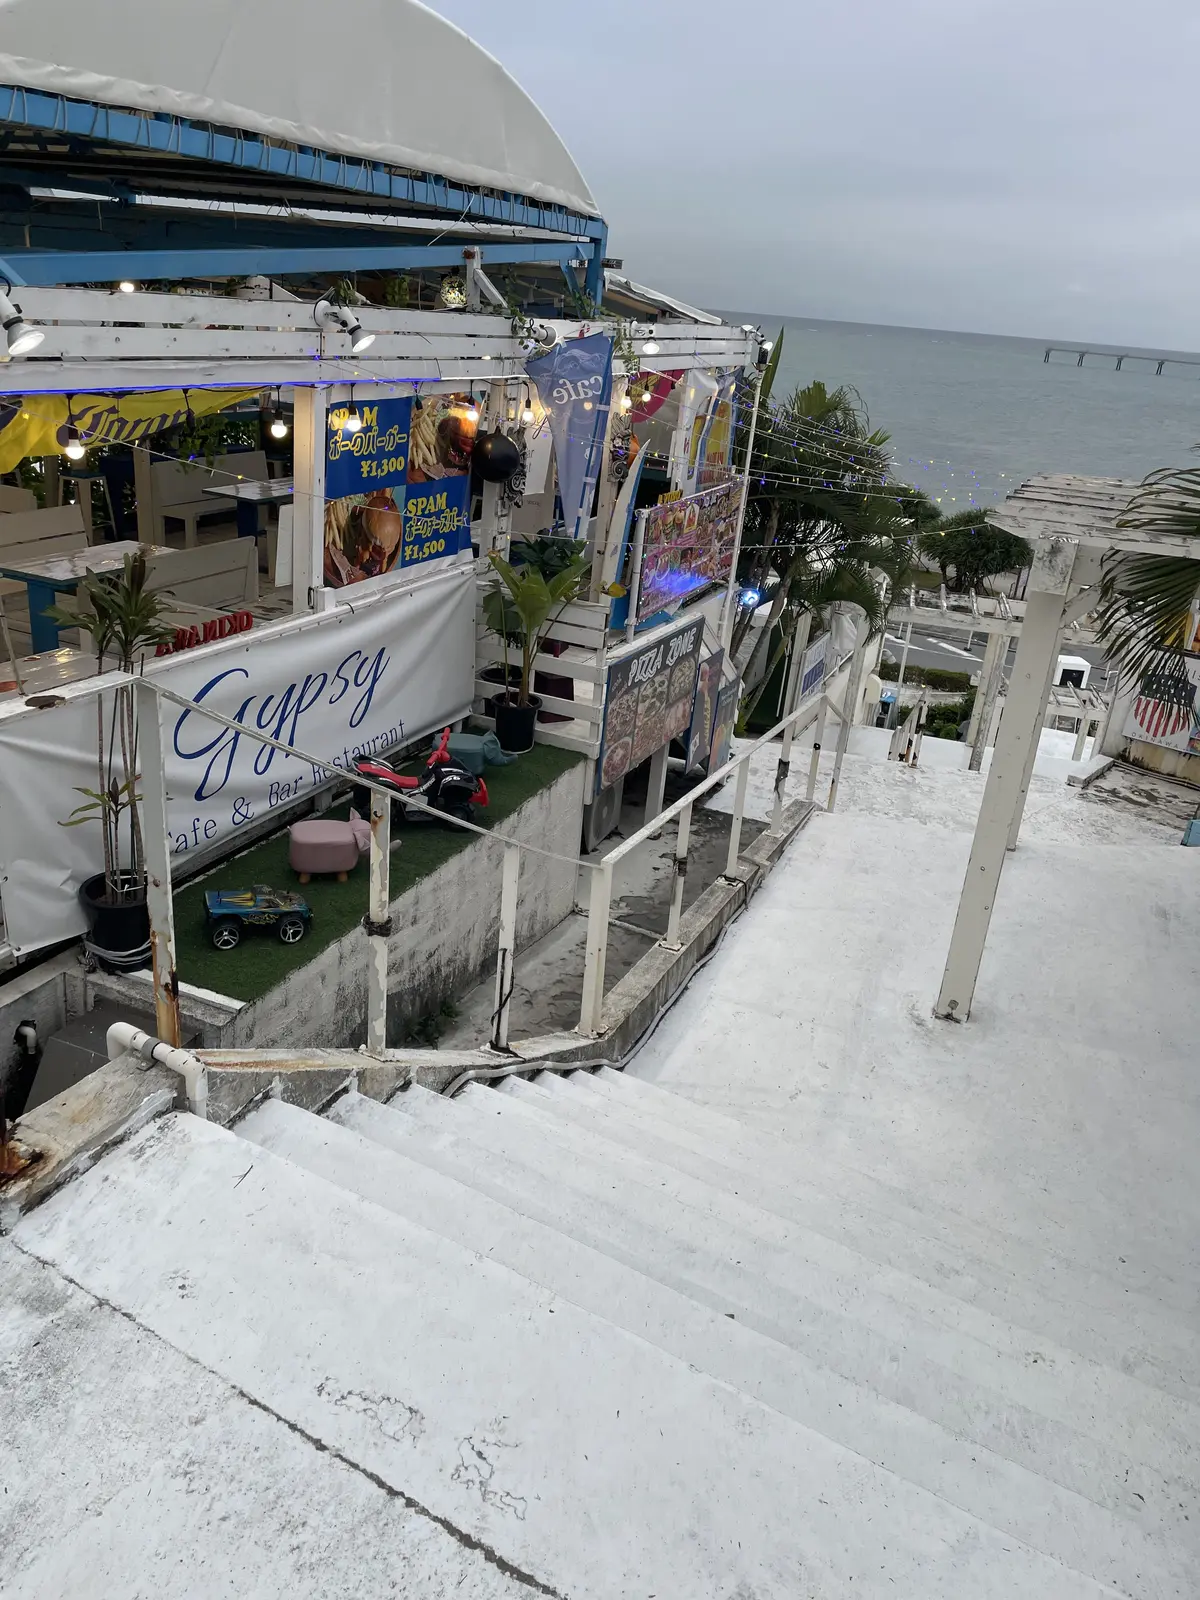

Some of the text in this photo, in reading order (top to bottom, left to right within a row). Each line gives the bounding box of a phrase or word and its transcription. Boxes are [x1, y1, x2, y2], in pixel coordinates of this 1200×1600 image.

[330, 406, 379, 431] SPM
[360, 456, 405, 479] ¥1,300
[407, 492, 448, 516] SPAM
[404, 538, 446, 561] ¥1,500
[627, 644, 665, 687] PIZZA
[666, 627, 698, 667] ZONE
[173, 646, 391, 802] Gypsy
[1131, 731, 1179, 749] OKINAWA
[167, 718, 405, 854] afe & Bar Restaurant
